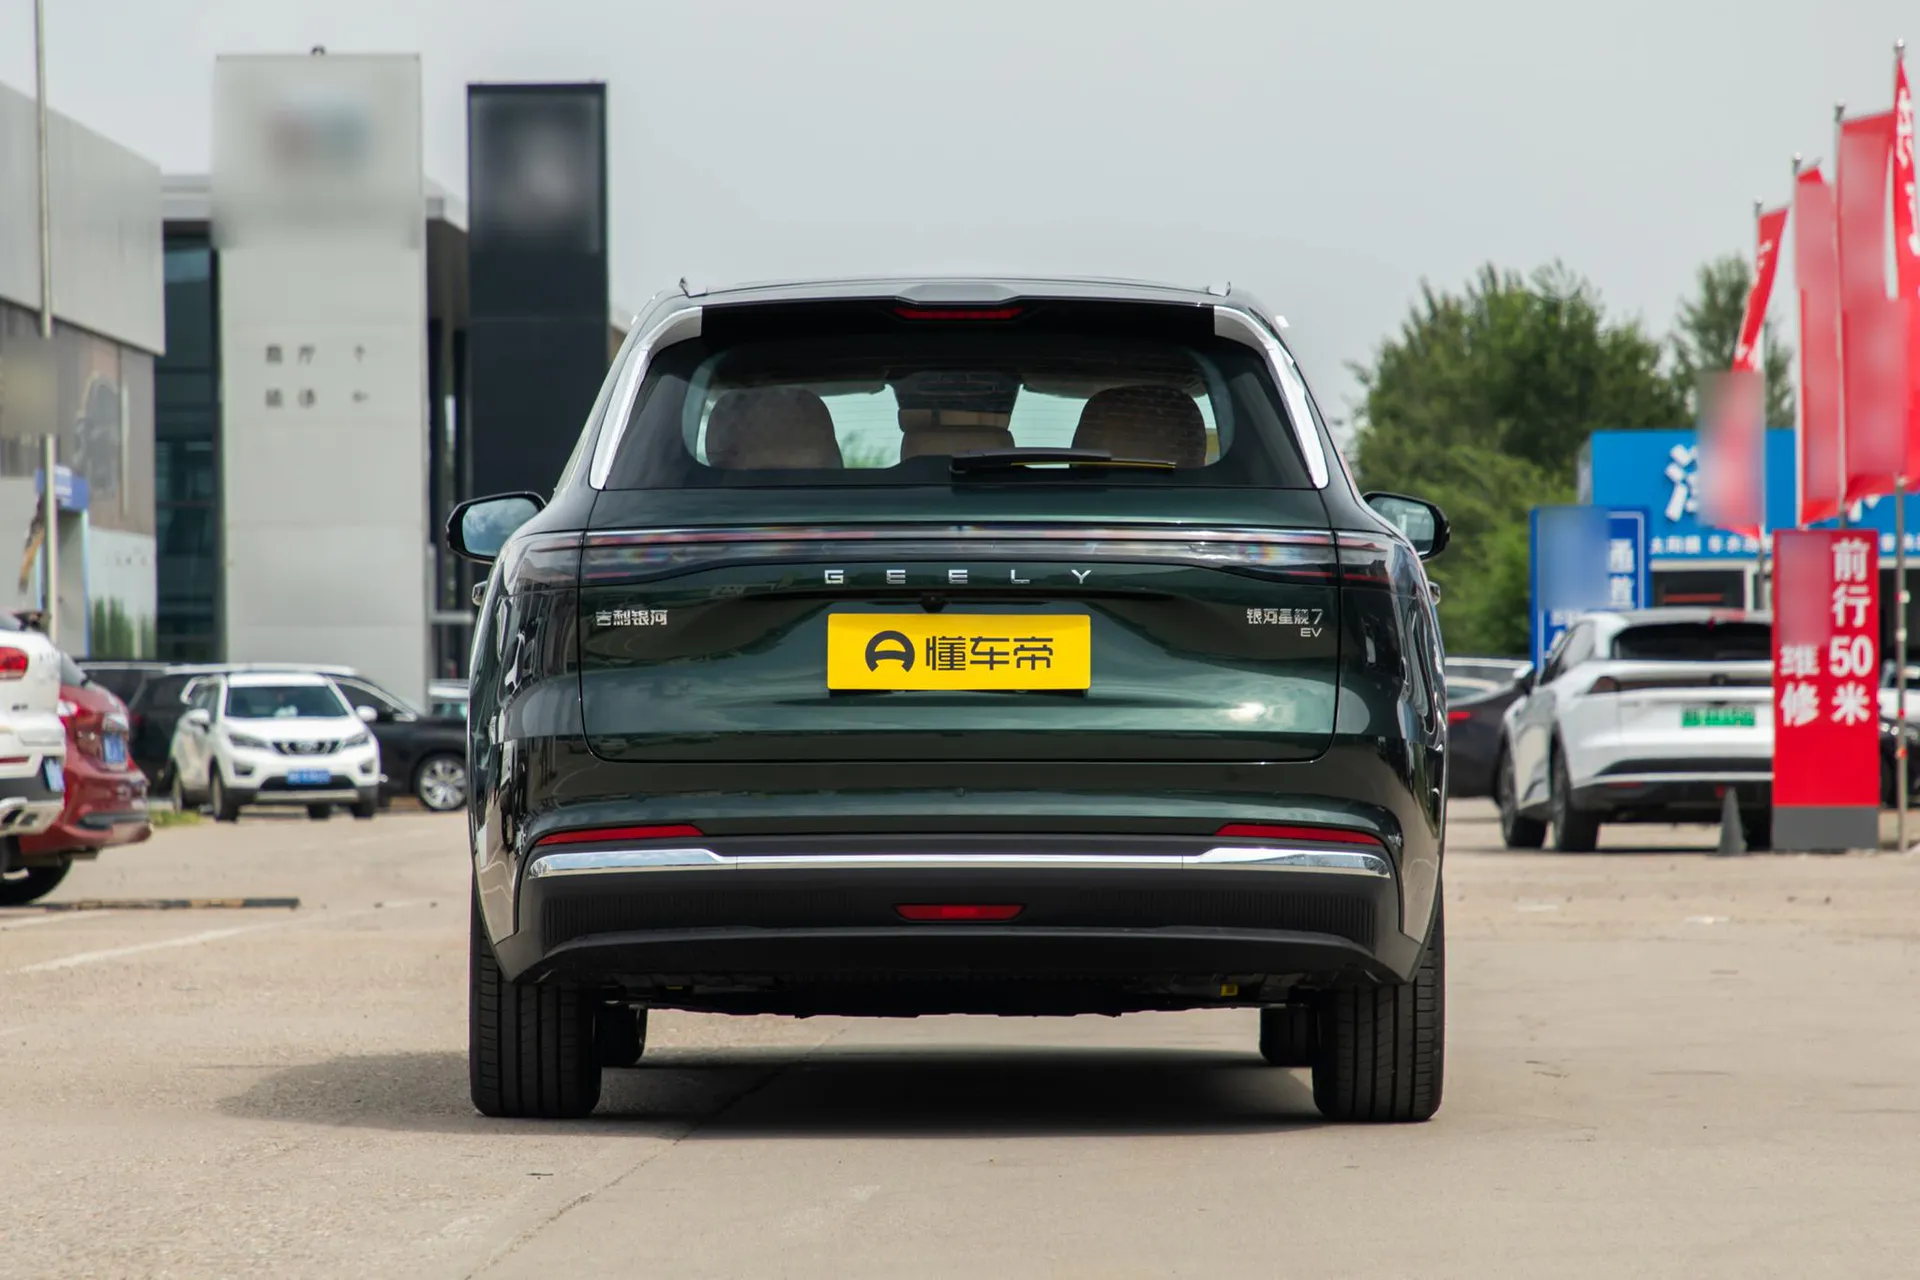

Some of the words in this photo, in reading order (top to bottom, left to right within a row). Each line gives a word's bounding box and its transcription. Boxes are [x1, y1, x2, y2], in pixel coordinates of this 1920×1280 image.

[824, 569, 1092, 585] GEELY
[595, 609, 669, 627] 吉利银河
[1300, 627, 1323, 638] EV
[1829, 537, 1874, 727] 前行50米
[926, 635, 1054, 671] 懂车帝
